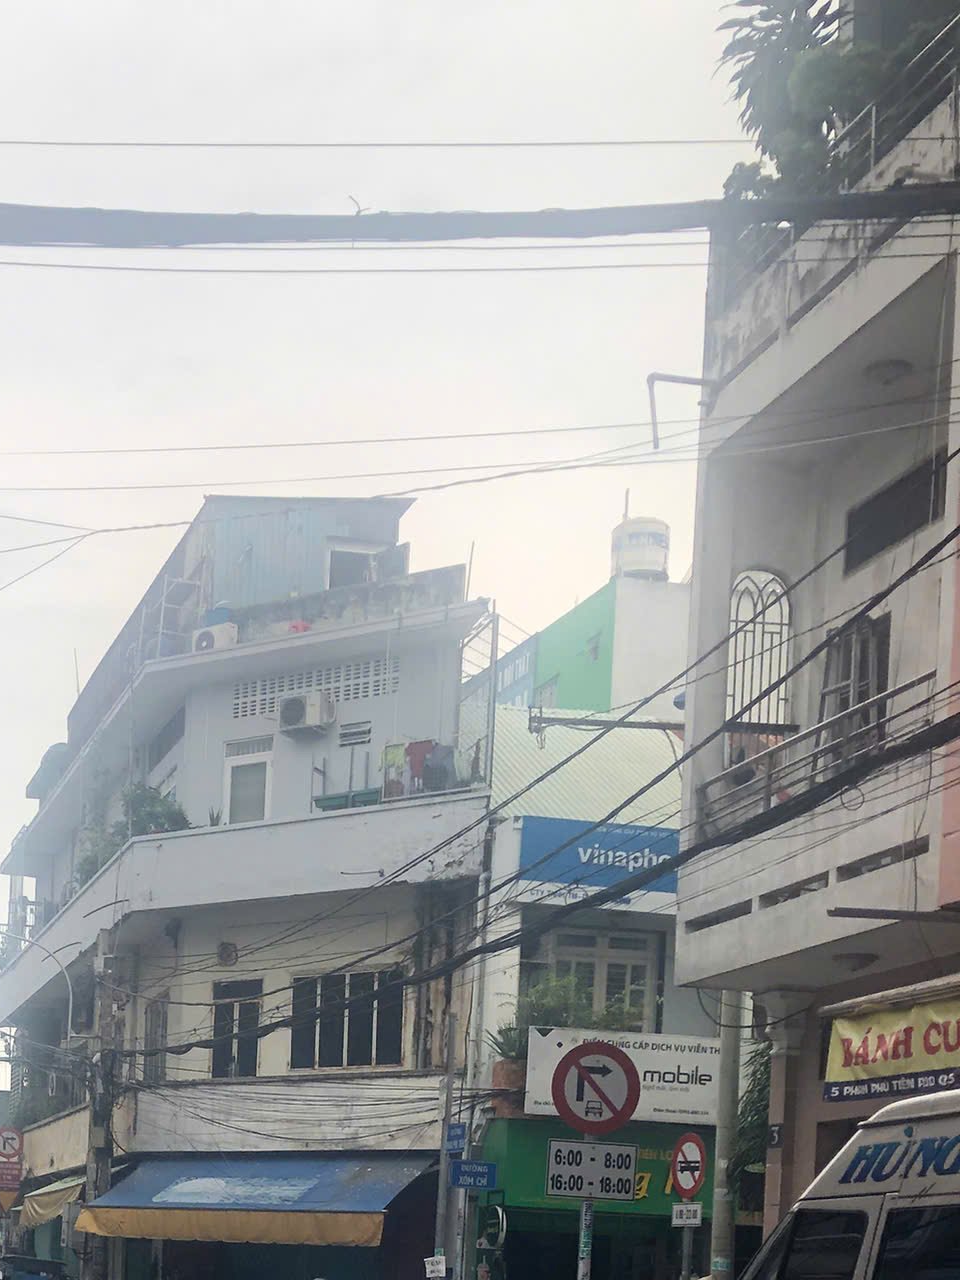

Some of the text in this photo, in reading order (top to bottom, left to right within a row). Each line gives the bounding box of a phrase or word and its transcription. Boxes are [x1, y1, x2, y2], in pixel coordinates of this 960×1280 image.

[841, 1026, 914, 1068] BÁNH
[643, 1065, 712, 1086] mobile
[771, 1125, 779, 1145] 3
[554, 1148, 583, 1167] 6:00
[604, 1152, 632, 1170] 8:00
[550, 1173, 584, 1192] 16:00
[599, 1176, 632, 1195] 18:00
